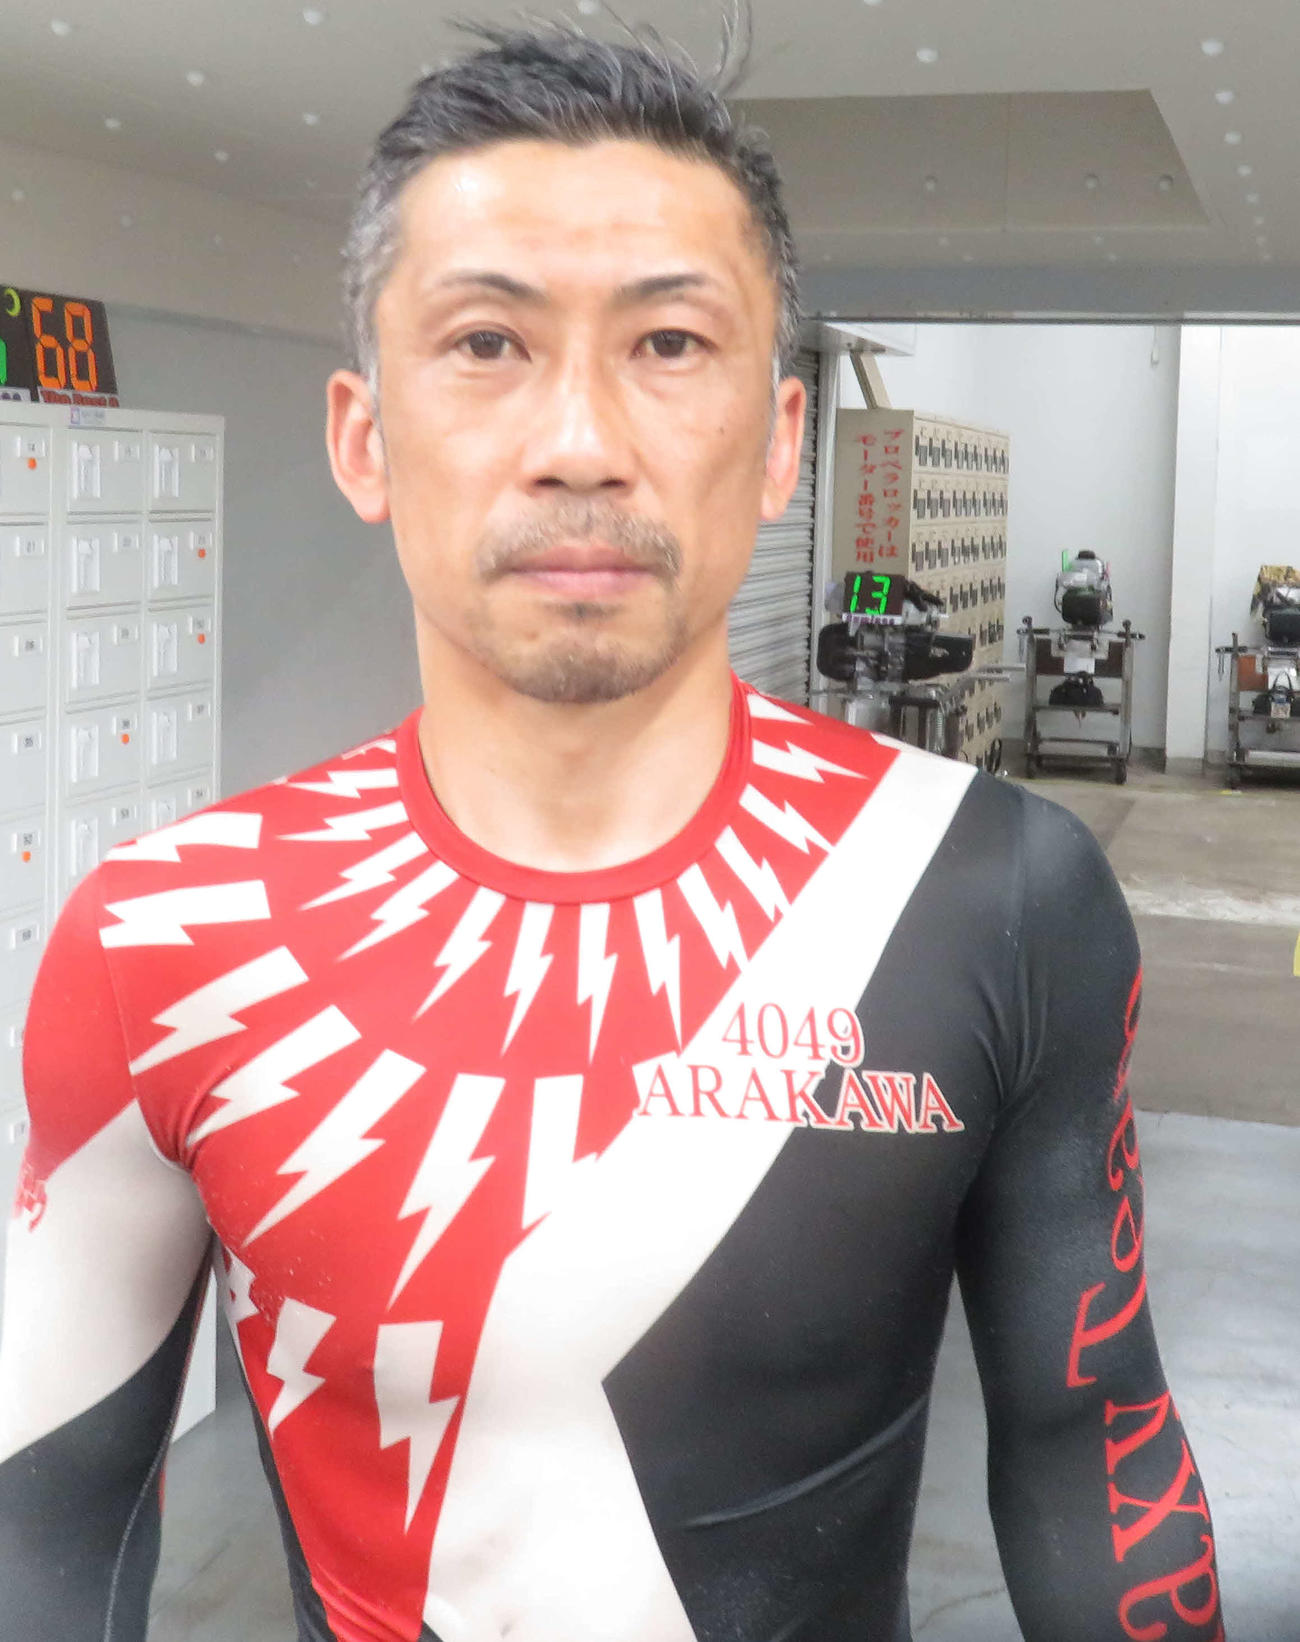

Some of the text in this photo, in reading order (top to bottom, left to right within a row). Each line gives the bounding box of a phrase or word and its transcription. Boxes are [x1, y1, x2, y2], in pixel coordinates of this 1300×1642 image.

[32, 296, 98, 392] 68
[850, 575, 891, 614] 13
[721, 1001, 863, 1065] 4049
[637, 1063, 964, 1133] ARAKAWA
